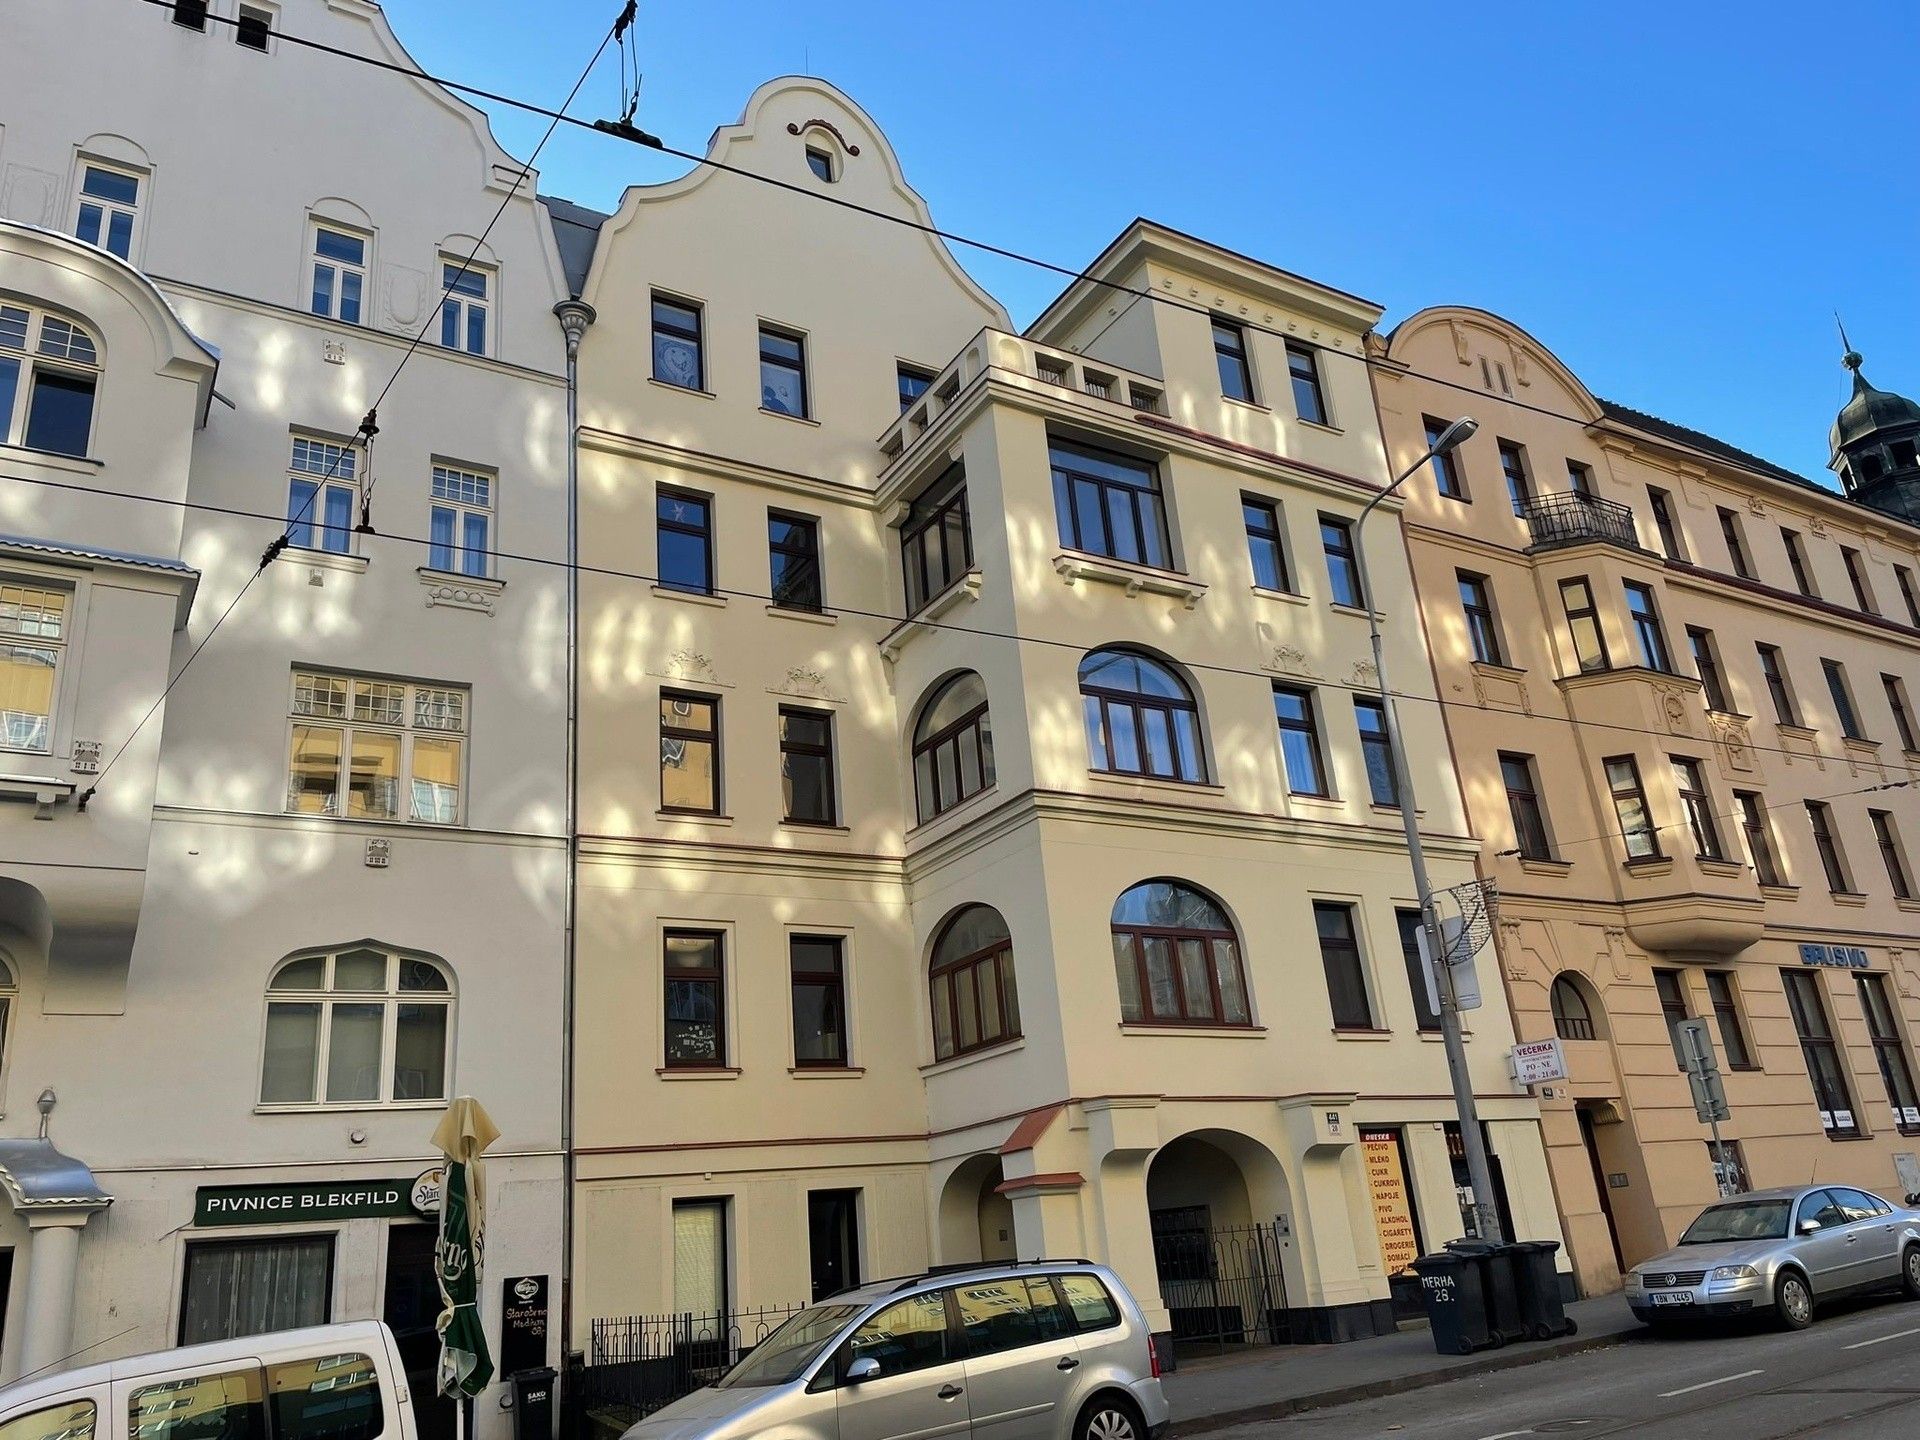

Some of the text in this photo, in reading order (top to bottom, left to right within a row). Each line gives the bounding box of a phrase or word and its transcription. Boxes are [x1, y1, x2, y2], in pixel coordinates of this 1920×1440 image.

[1517, 1043, 1553, 1056] VEČERKA
[1371, 1168, 1388, 1176] CUKR
[207, 1191, 399, 1211] PIVNICE BLEKFILD
[1378, 1205, 1392, 1213] PIVO
[1380, 1215, 1408, 1224] ALKOHOL
[1382, 1228, 1412, 1237] CIGARETY
[1384, 1241, 1415, 1250] DROGERIE
[1421, 1275, 1455, 1288] MERHA
